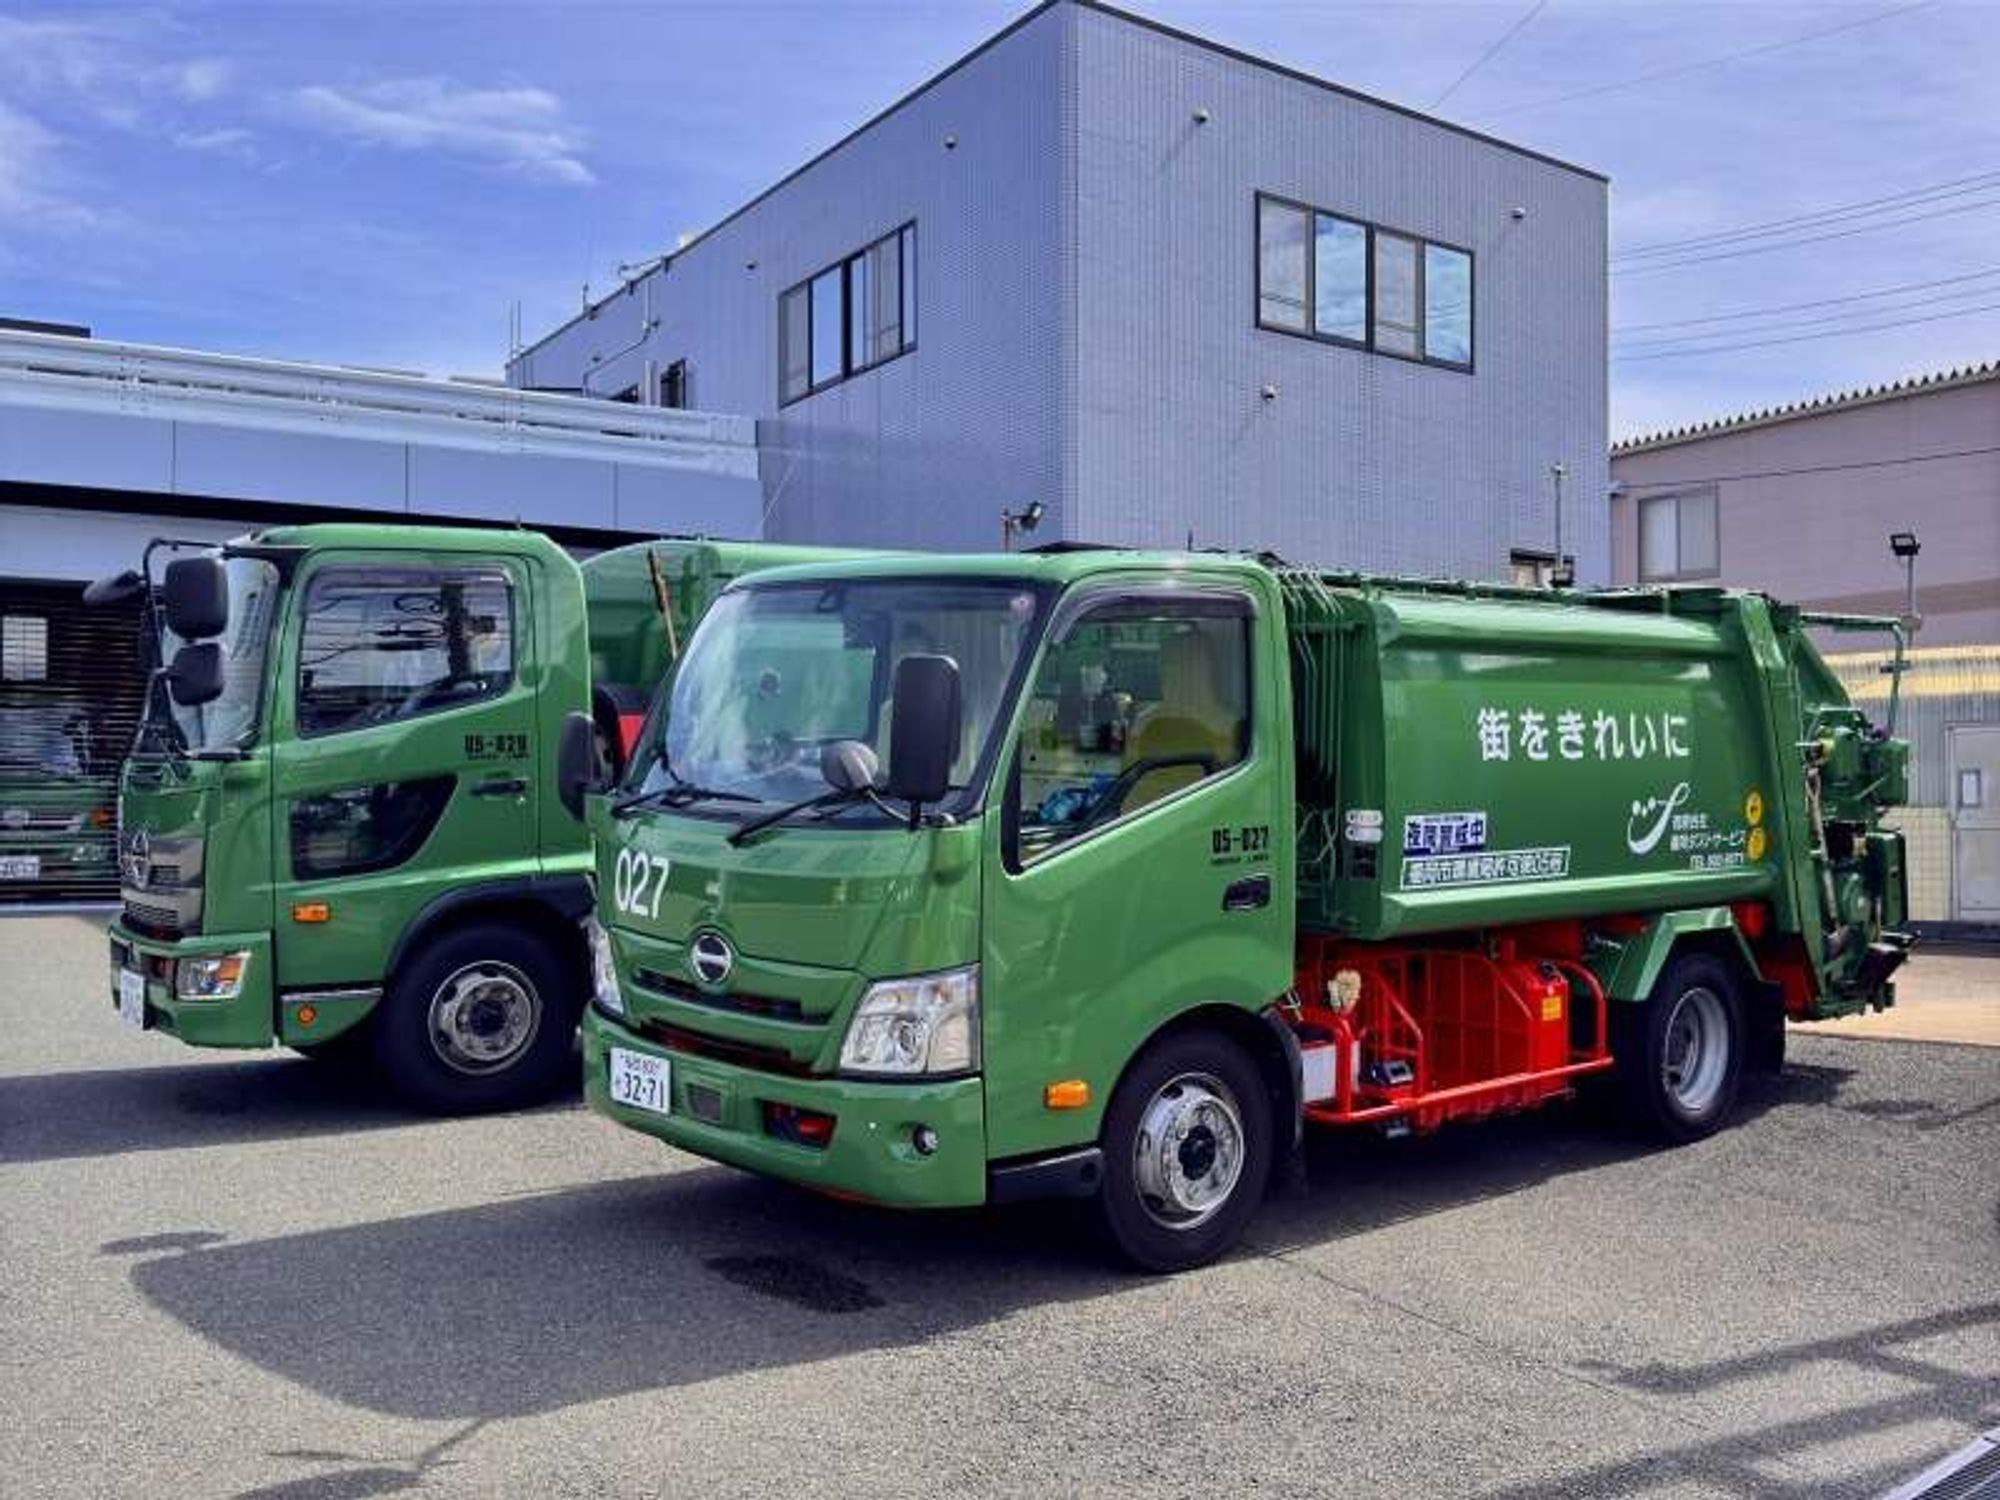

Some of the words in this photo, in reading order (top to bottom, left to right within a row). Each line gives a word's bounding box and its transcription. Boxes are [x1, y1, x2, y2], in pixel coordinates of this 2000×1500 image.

[1478, 707, 1691, 761] 街をきれいに
[615, 848, 670, 921] 027
